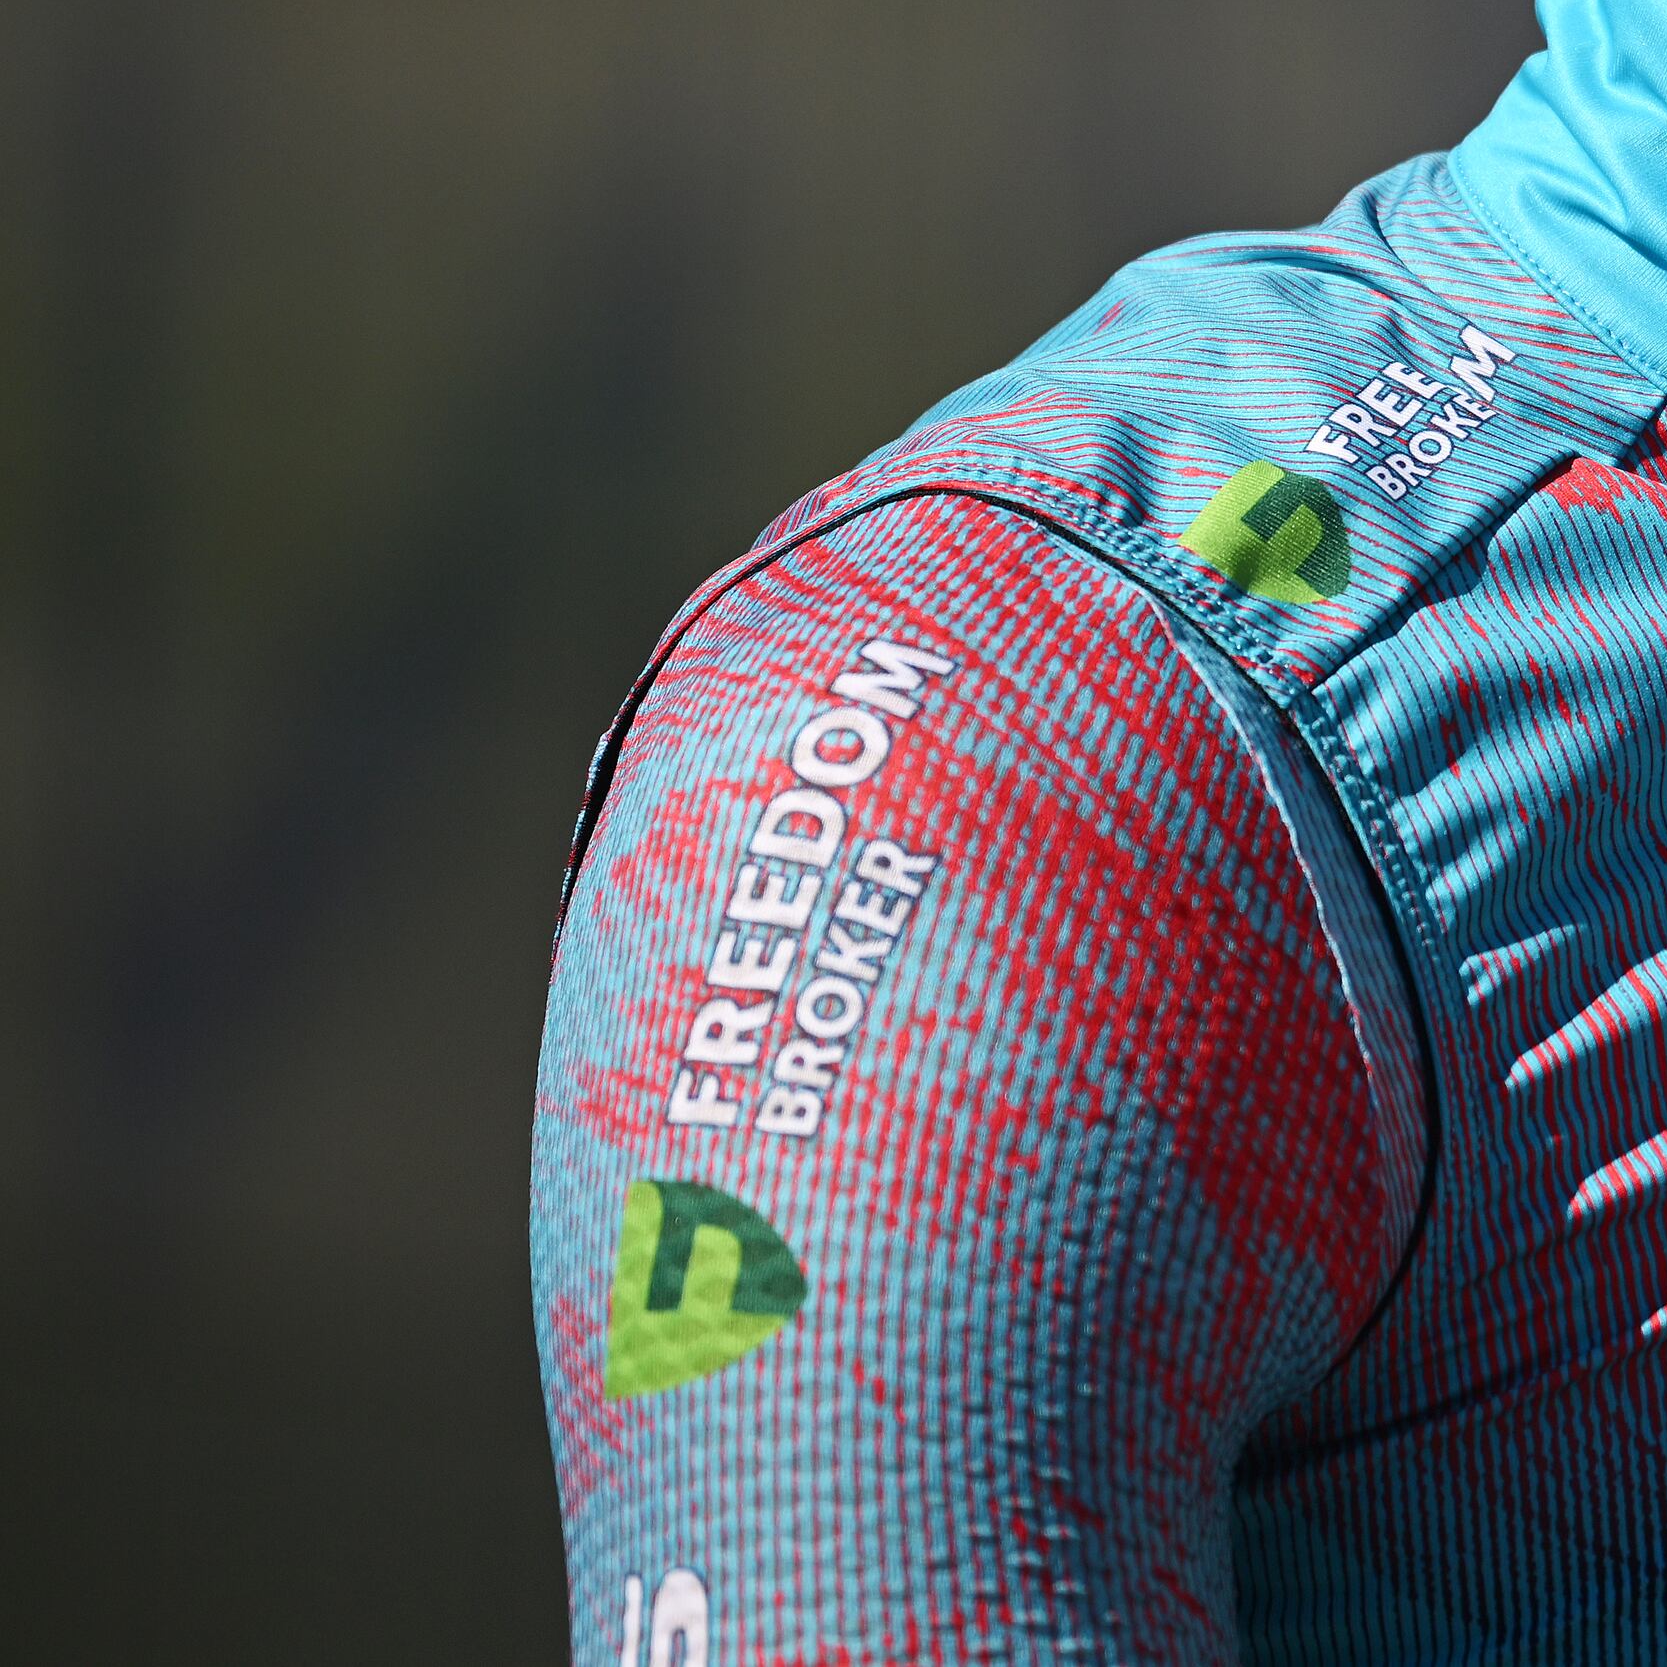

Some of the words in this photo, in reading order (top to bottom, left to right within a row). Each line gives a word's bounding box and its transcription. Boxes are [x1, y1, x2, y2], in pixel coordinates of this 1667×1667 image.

[1366, 389, 1499, 502] BROKE
[666, 638, 960, 1127] FREEDOM
[754, 838, 943, 1138] BROKER
